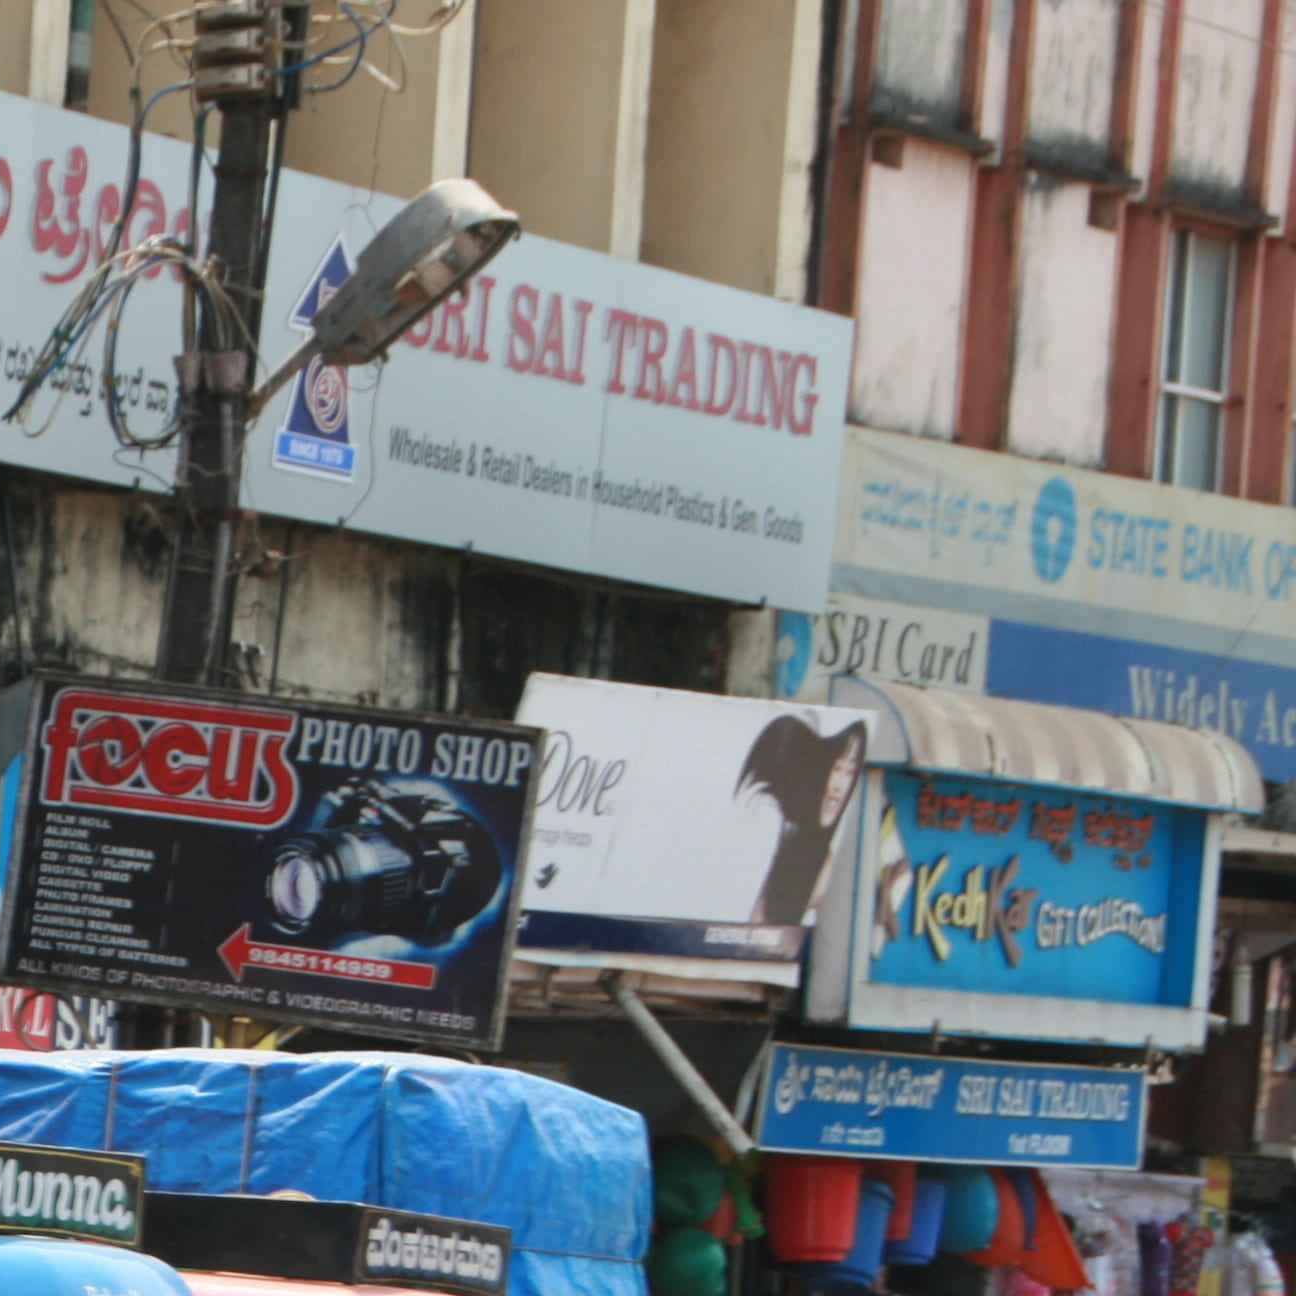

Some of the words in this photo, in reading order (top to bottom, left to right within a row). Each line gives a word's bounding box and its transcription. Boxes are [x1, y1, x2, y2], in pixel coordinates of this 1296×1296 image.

[504, 283, 595, 385] SAI
[602, 306, 820, 436] TRADING
[388, 424, 463, 474] Wholesale
[465, 442, 477, 477] &
[479, 446, 522, 486] Retail
[522, 455, 575, 499] Dealers
[716, 496, 729, 529] &
[762, 506, 805, 545] Goods
[1087, 506, 1173, 580] STATE
[1179, 522, 1256, 596] BANK
[816, 609, 887, 675] SBI
[896, 621, 979, 691] Card
[296, 716, 424, 775] PHOTO
[430, 731, 533, 788] SHOP
[16, 957, 49, 975] ALL
[106, 969, 128, 985] OF
[247, 947, 392, 980] 9845114959
[955, 1074, 995, 1116] SRI
[996, 1077, 1036, 1118] SAI
[1037, 1080, 1131, 1123] TRADING
